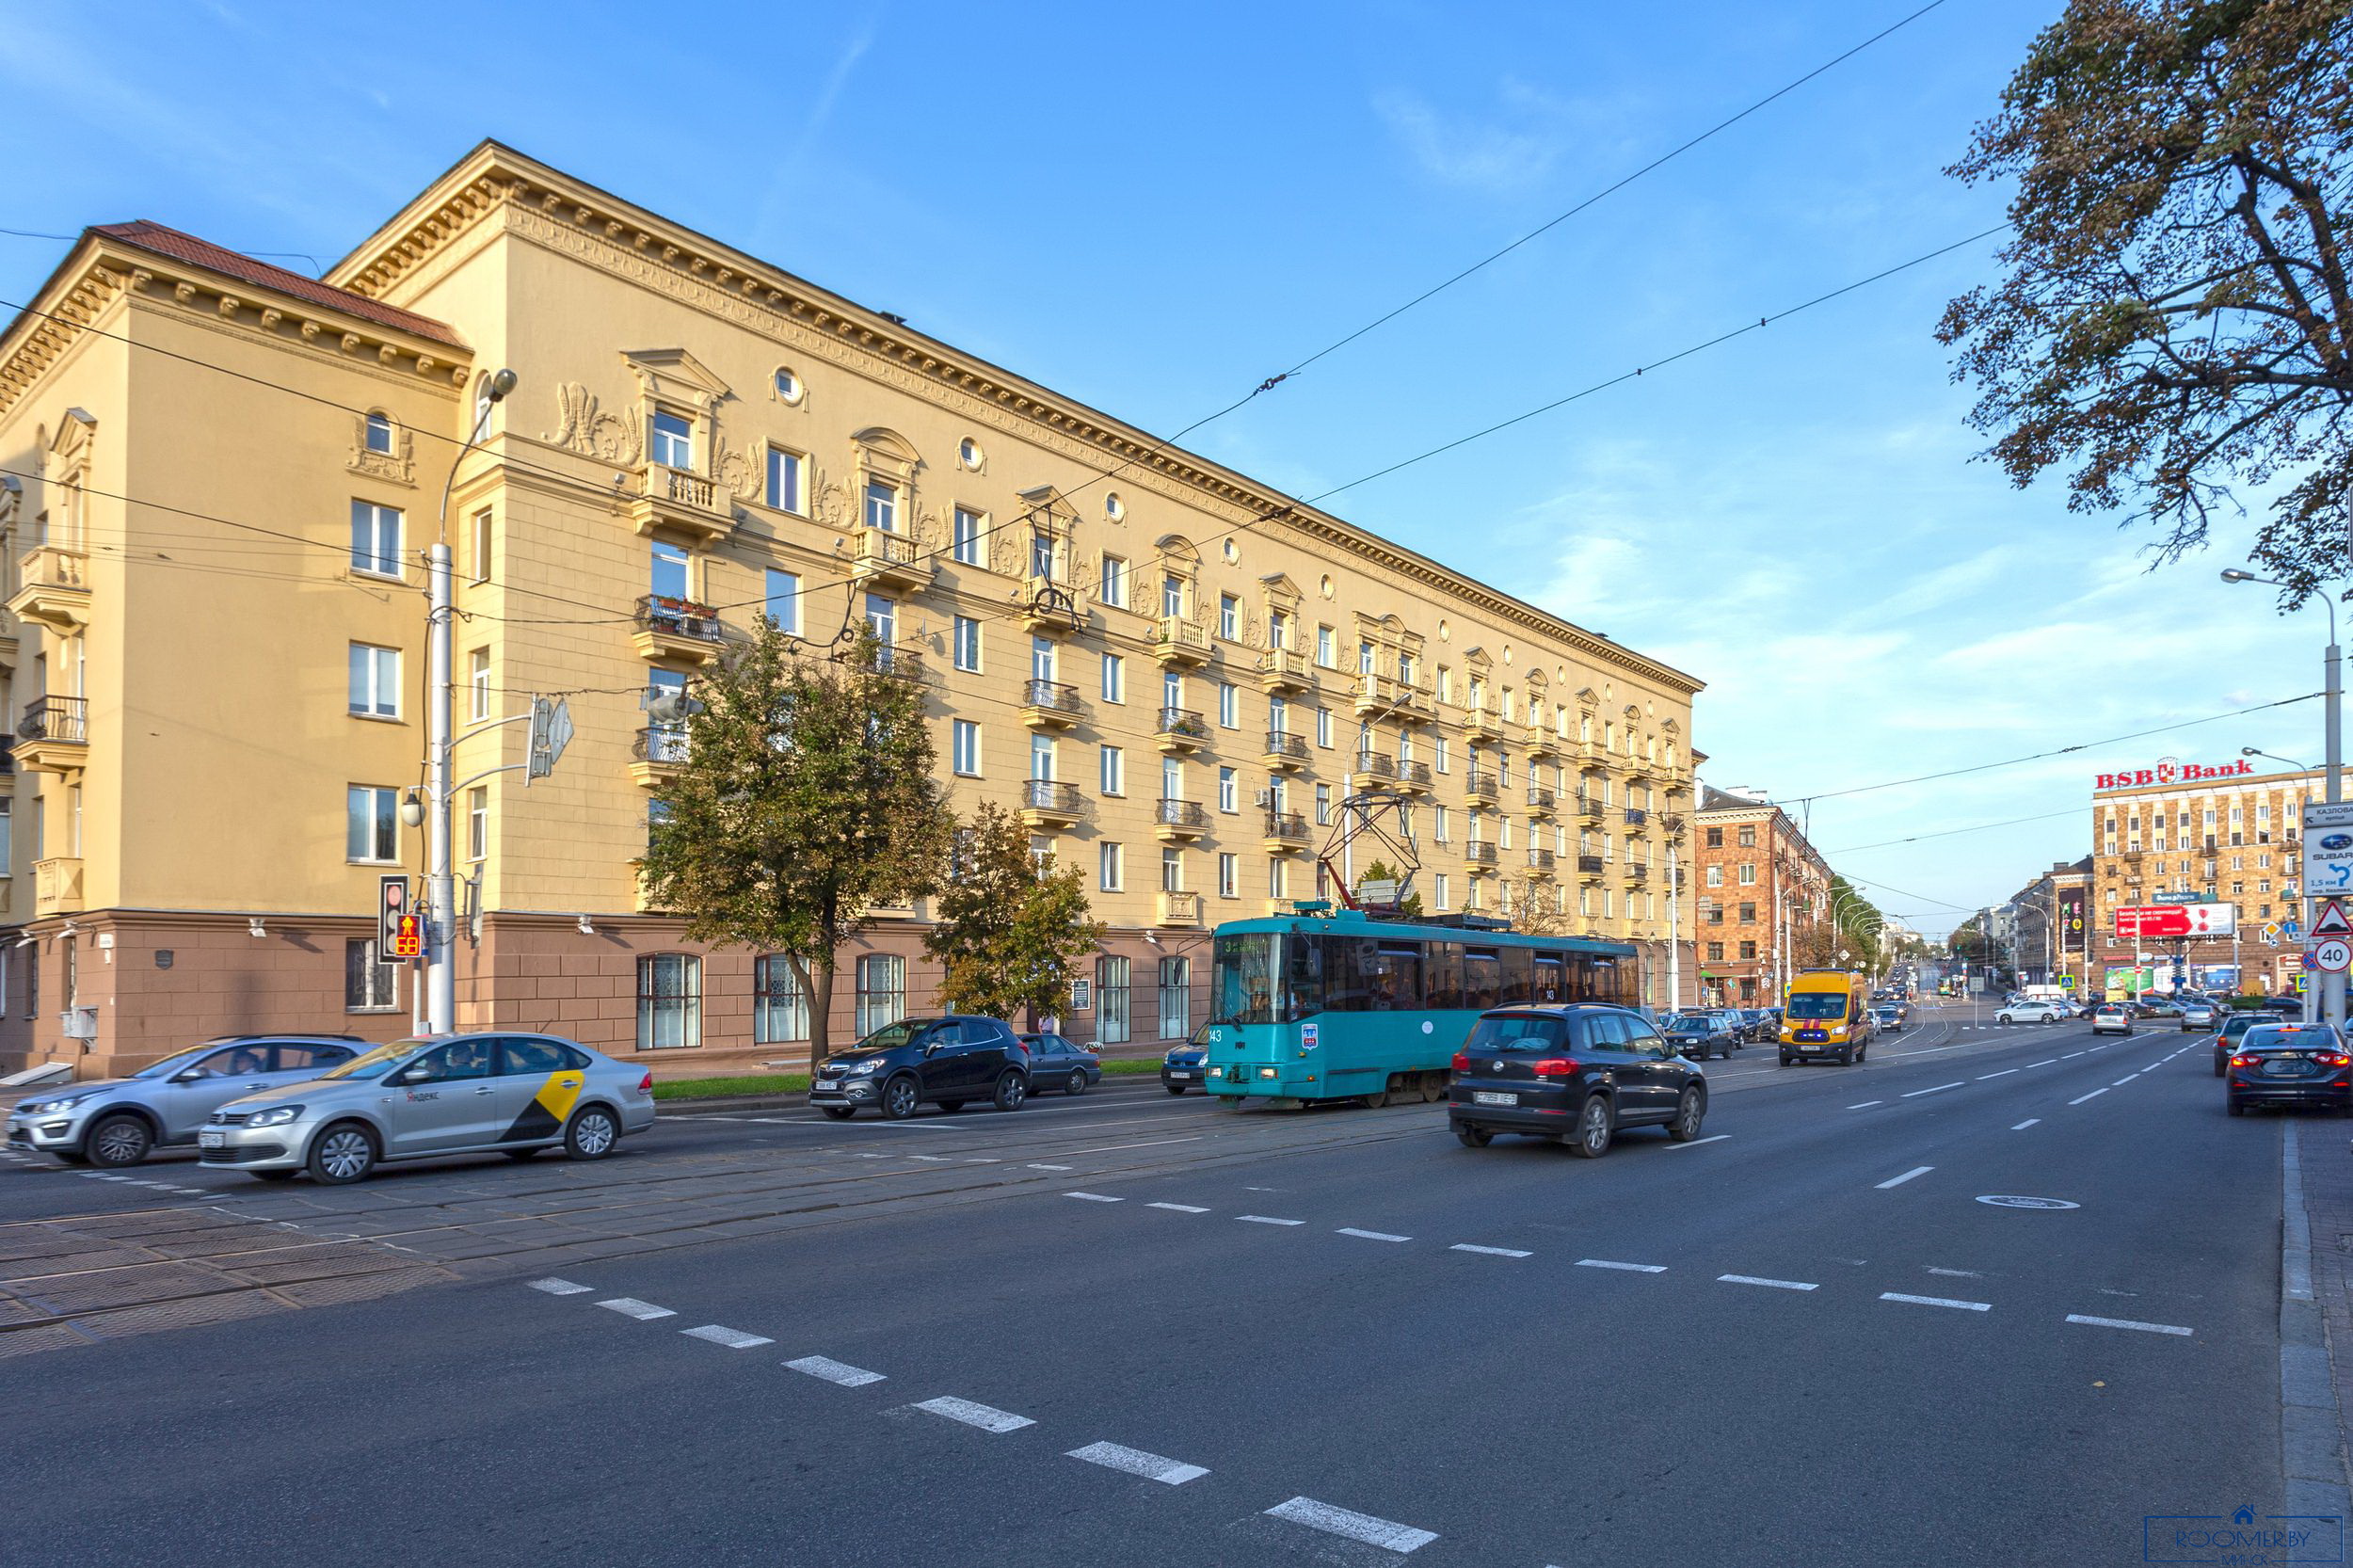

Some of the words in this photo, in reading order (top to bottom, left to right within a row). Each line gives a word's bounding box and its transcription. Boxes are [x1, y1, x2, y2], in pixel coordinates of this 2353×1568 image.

[2095, 770, 2153, 790] BSB
[2181, 759, 2255, 780] Bank
[396, 936, 418, 955] 68
[2321, 949, 2344, 963] 40
[1209, 1030, 1222, 1042] 143
